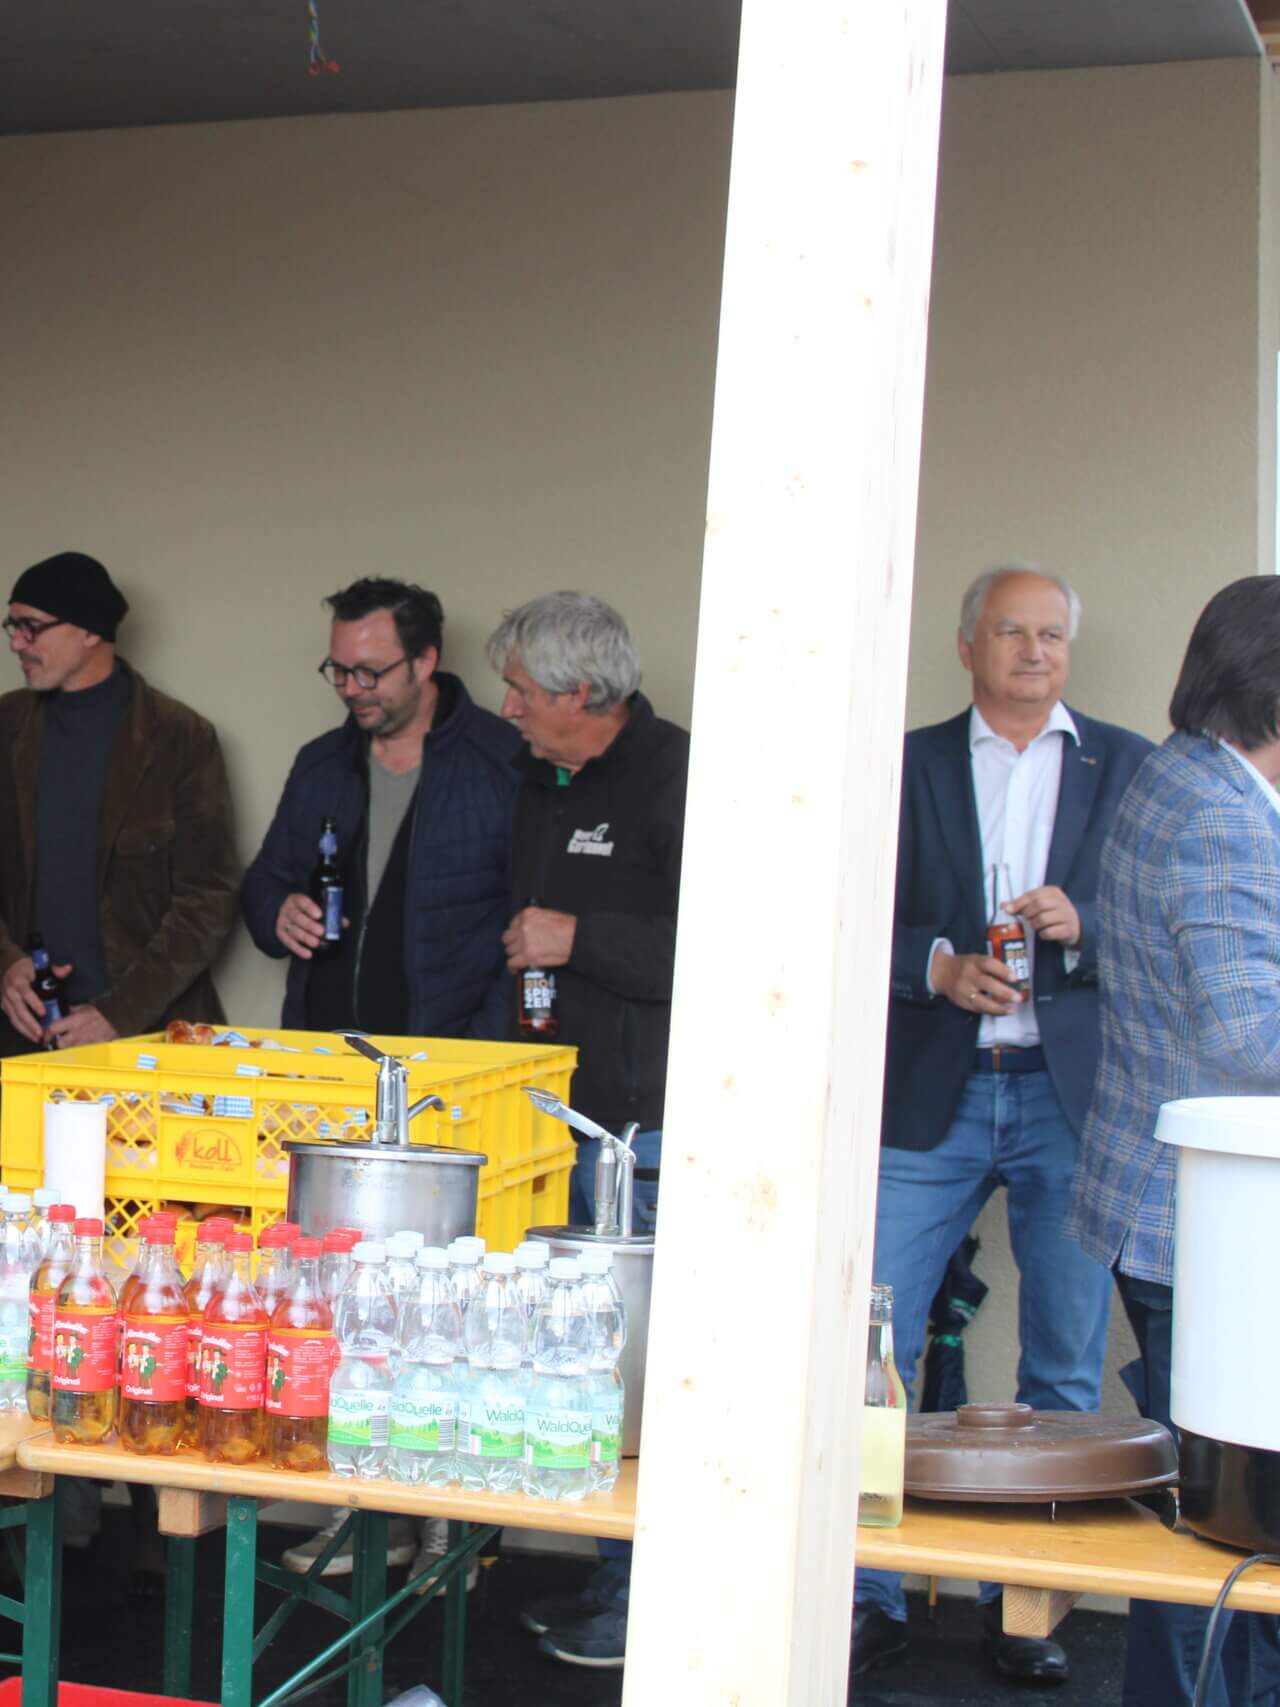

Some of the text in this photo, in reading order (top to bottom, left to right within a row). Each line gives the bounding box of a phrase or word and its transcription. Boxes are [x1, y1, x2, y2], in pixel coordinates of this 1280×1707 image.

[331, 1397, 374, 1413] dQuelle
[485, 1409, 524, 1422] WaldQ
[536, 1418, 592, 1435] WaldQue
